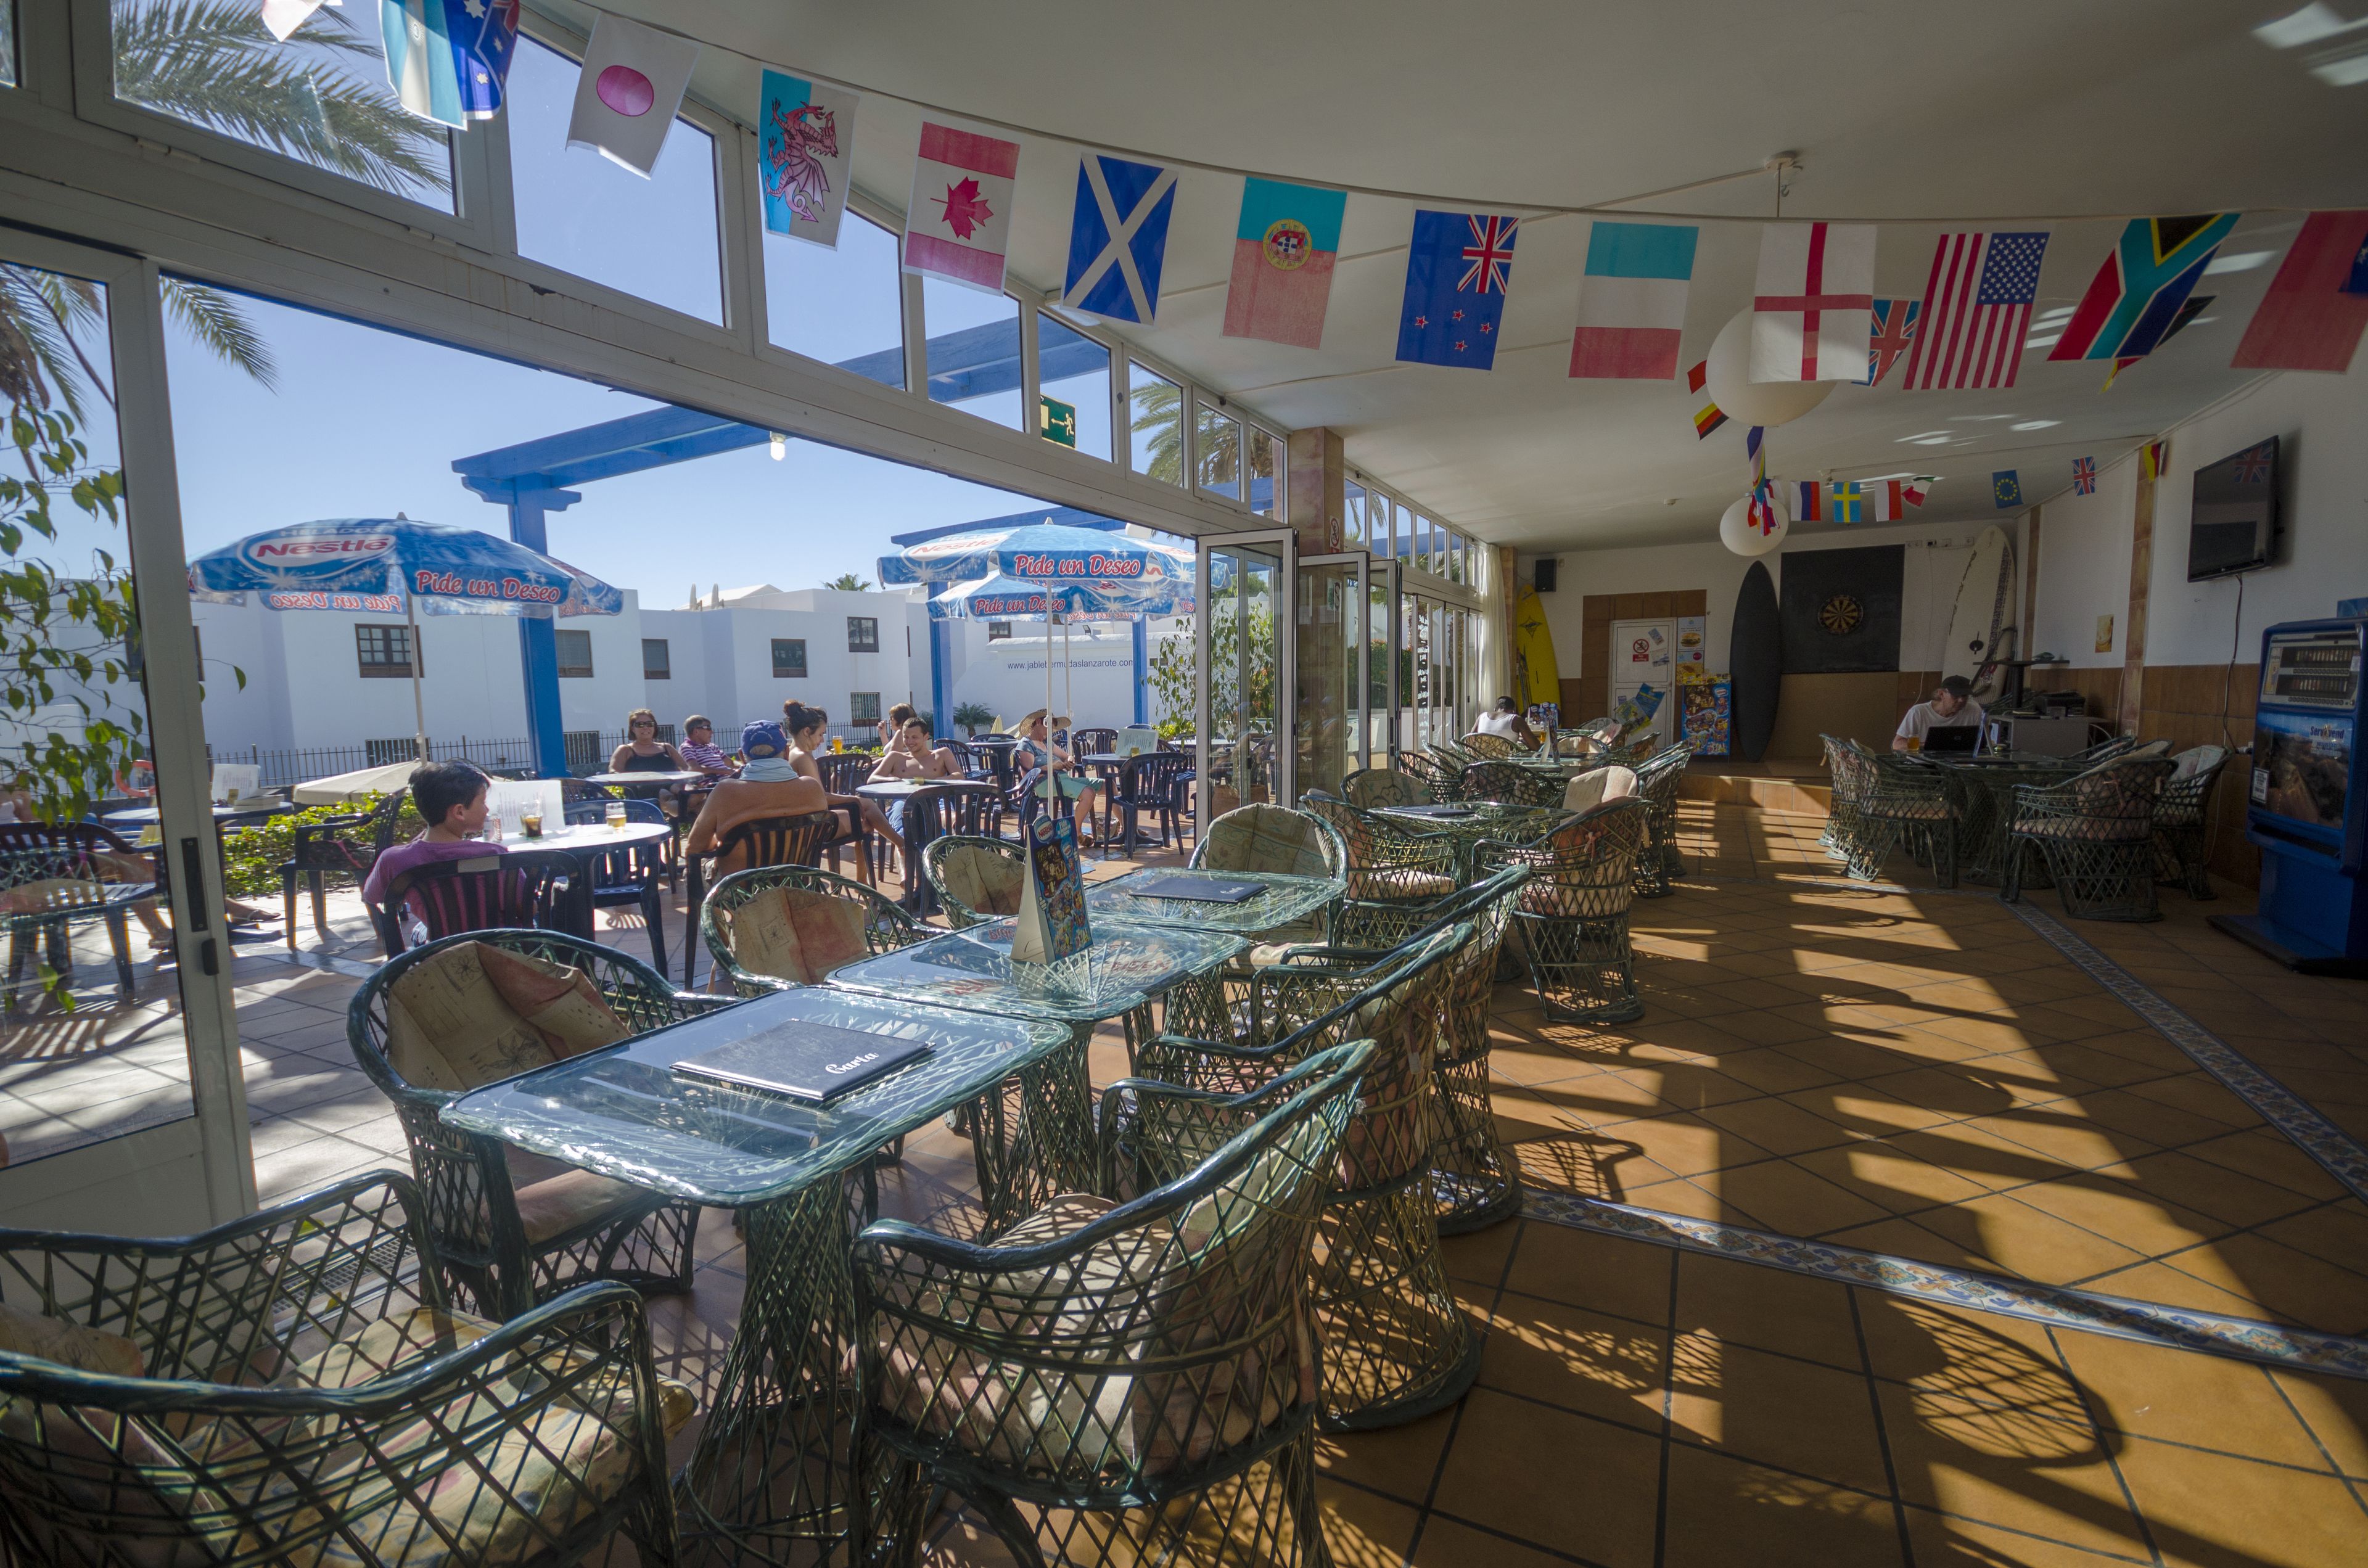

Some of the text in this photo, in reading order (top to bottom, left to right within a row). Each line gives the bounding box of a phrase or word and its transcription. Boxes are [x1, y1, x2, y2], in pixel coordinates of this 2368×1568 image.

[256, 538, 390, 557] Nestlé
[1014, 554, 1054, 575] Pide
[1059, 559, 1085, 575] un
[1089, 554, 1141, 576] Deseo
[416, 570, 462, 594] Pide
[467, 578, 498, 596] un
[502, 577, 561, 602] Deseo
[975, 597, 1004, 615] Pide
[1006, 599, 1026, 612] un
[824, 1052, 879, 1074] Carta
